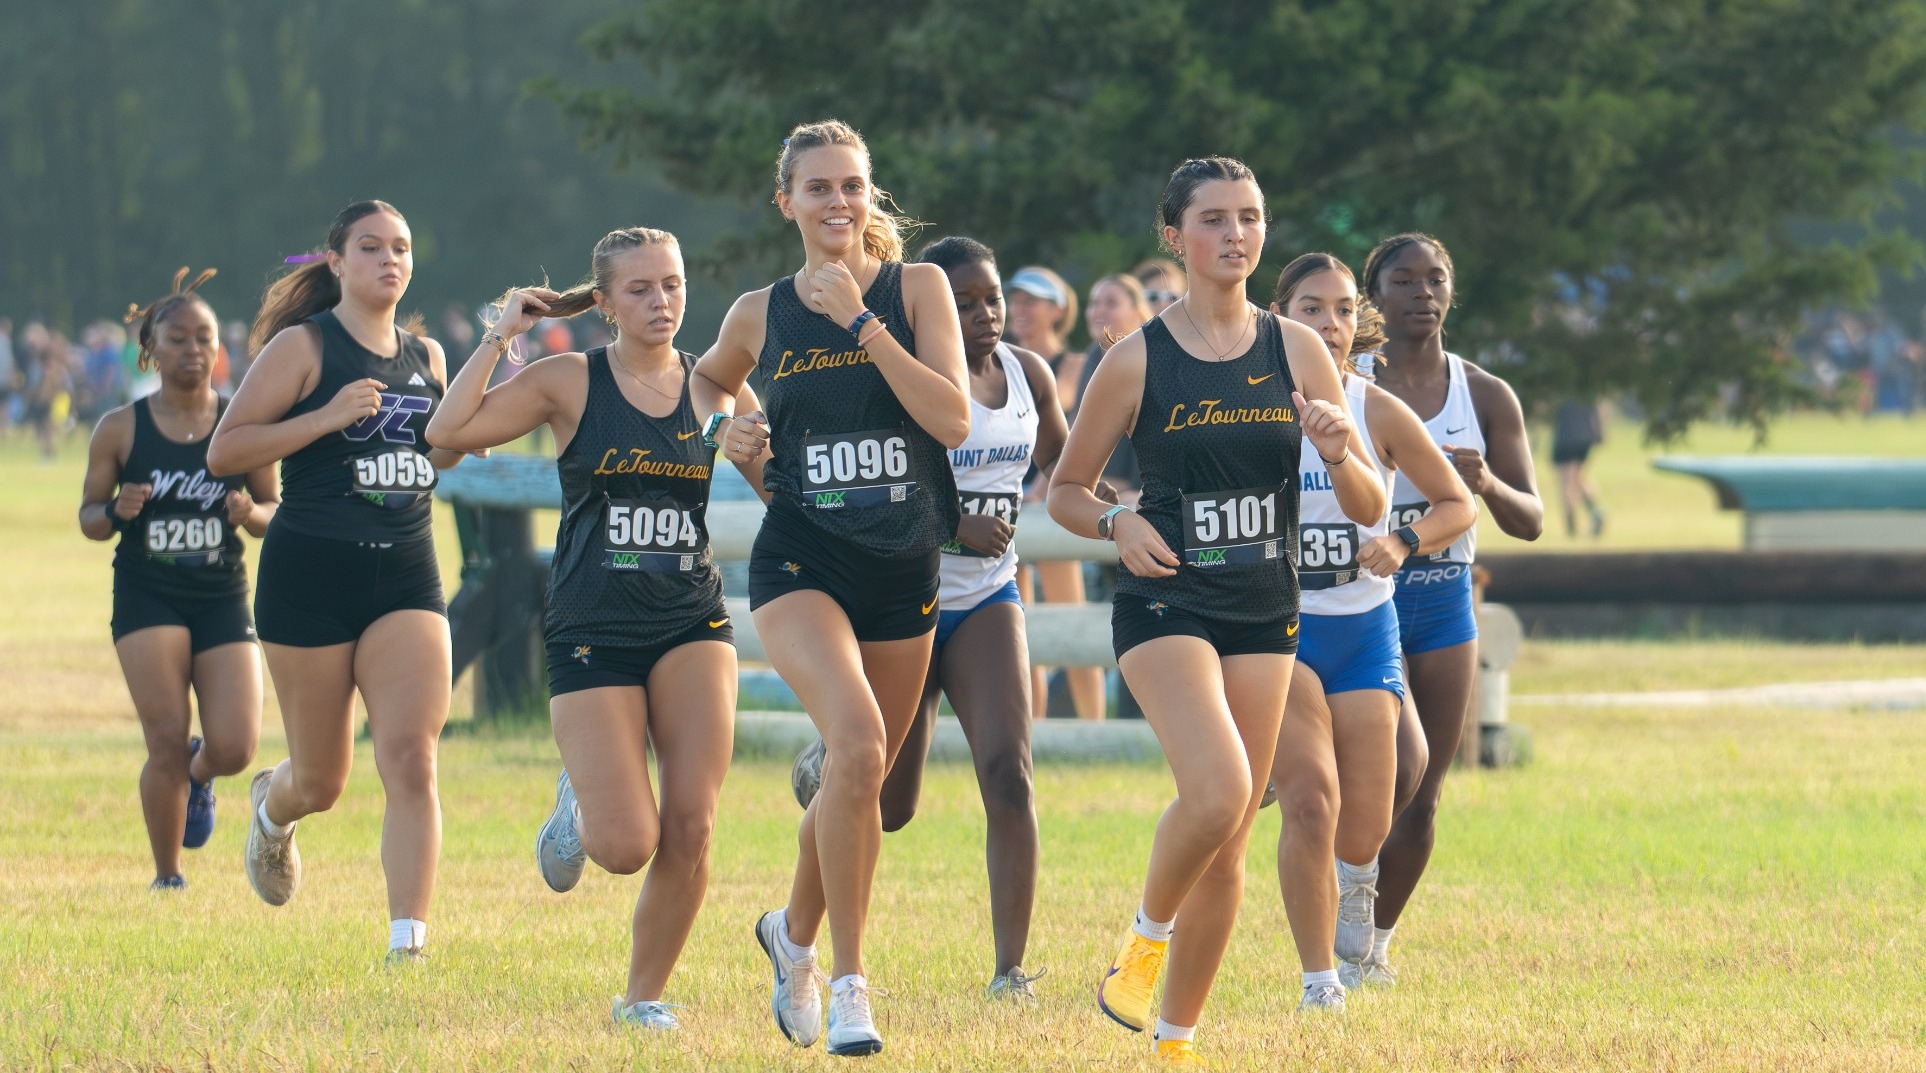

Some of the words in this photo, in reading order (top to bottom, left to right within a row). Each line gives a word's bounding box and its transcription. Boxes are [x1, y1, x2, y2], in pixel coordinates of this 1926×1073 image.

[773, 347, 873, 381] LeTourn
[1164, 399, 1294, 432] LeTourneau
[356, 451, 435, 488] 5059
[594, 448, 710, 480] LeTourneau
[806, 436, 908, 485] 5096
[953, 448, 984, 467] UNT
[987, 444, 1029, 464] DALLAS
[150, 468, 226, 511] Wiley
[1300, 471, 1333, 492] ALL
[815, 491, 847, 505] NTX
[959, 497, 1013, 526] 143
[609, 506, 698, 548] 5094
[1193, 493, 1277, 541] 5101
[149, 517, 223, 552] 5260
[612, 553, 641, 564] NTX
[1197, 549, 1227, 562] NTX
[1404, 565, 1461, 586] PRO
